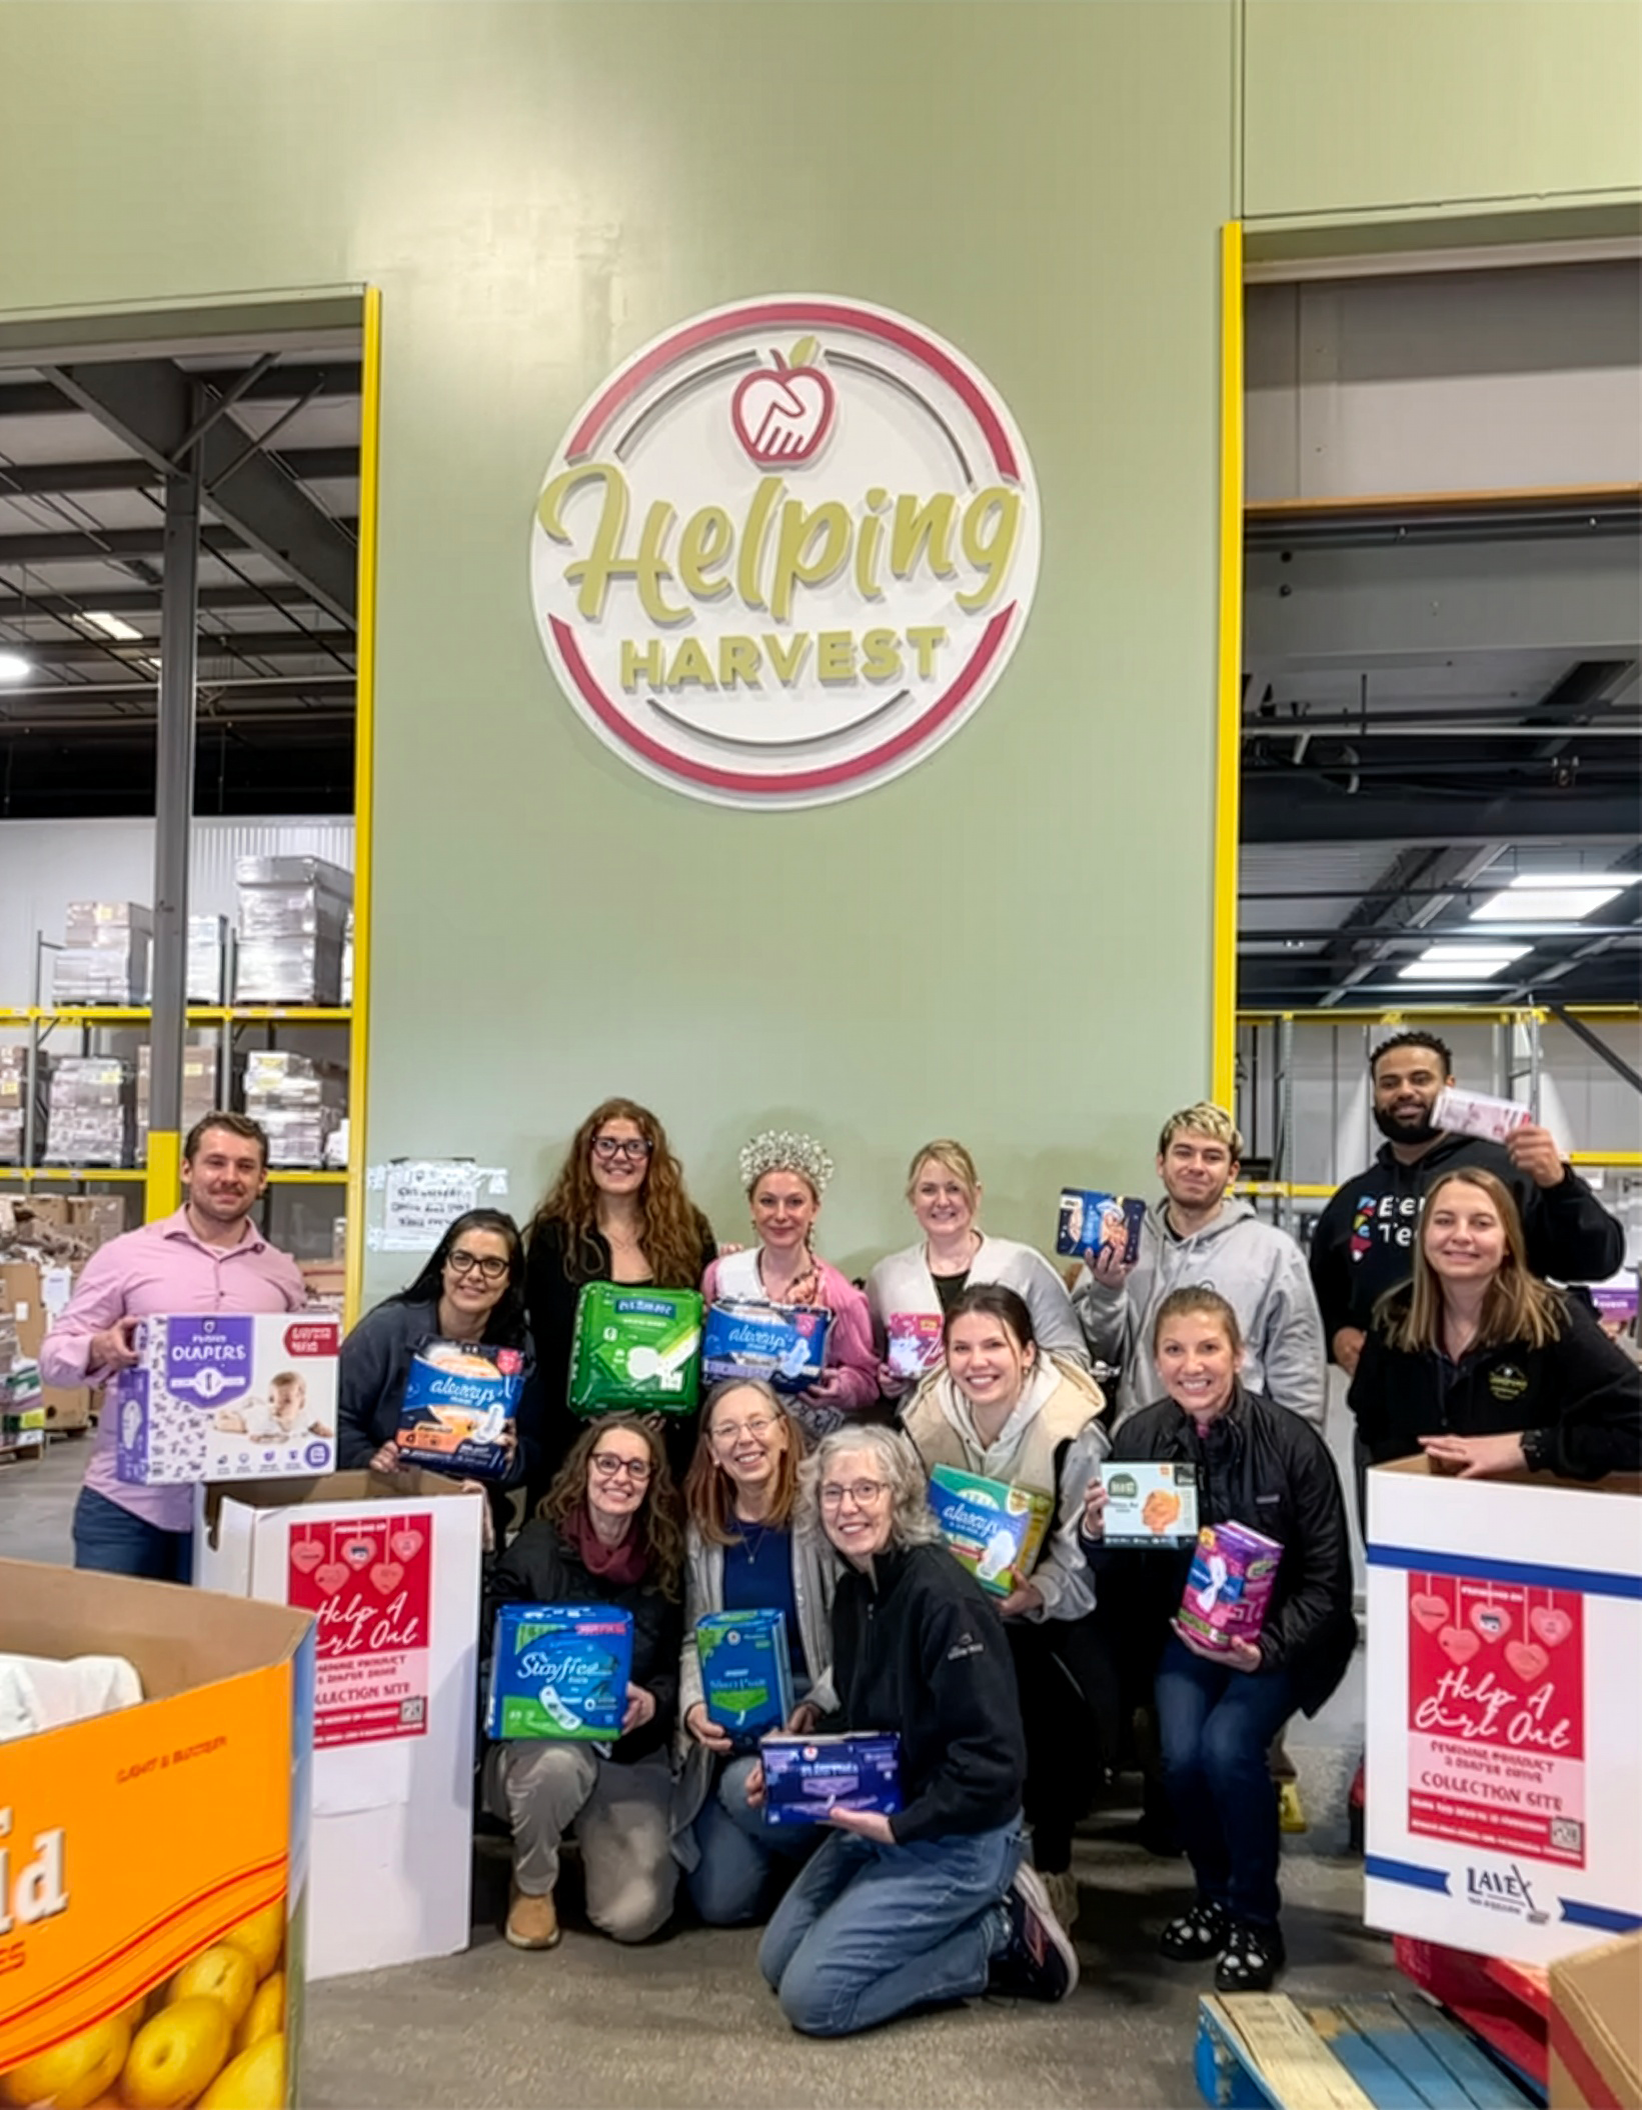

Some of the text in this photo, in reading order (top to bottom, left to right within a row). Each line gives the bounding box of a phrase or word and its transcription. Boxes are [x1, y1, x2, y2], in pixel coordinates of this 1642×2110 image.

[538, 463, 1022, 624] Helping
[620, 626, 948, 691] HARVEST
[429, 1376, 495, 1407] always
[316, 1590, 409, 1626] Help A
[1436, 1666, 1554, 1720] Help A
[1415, 1696, 1571, 1750] Girl Out
[1421, 1771, 1563, 1812] COLLECTION SITE
